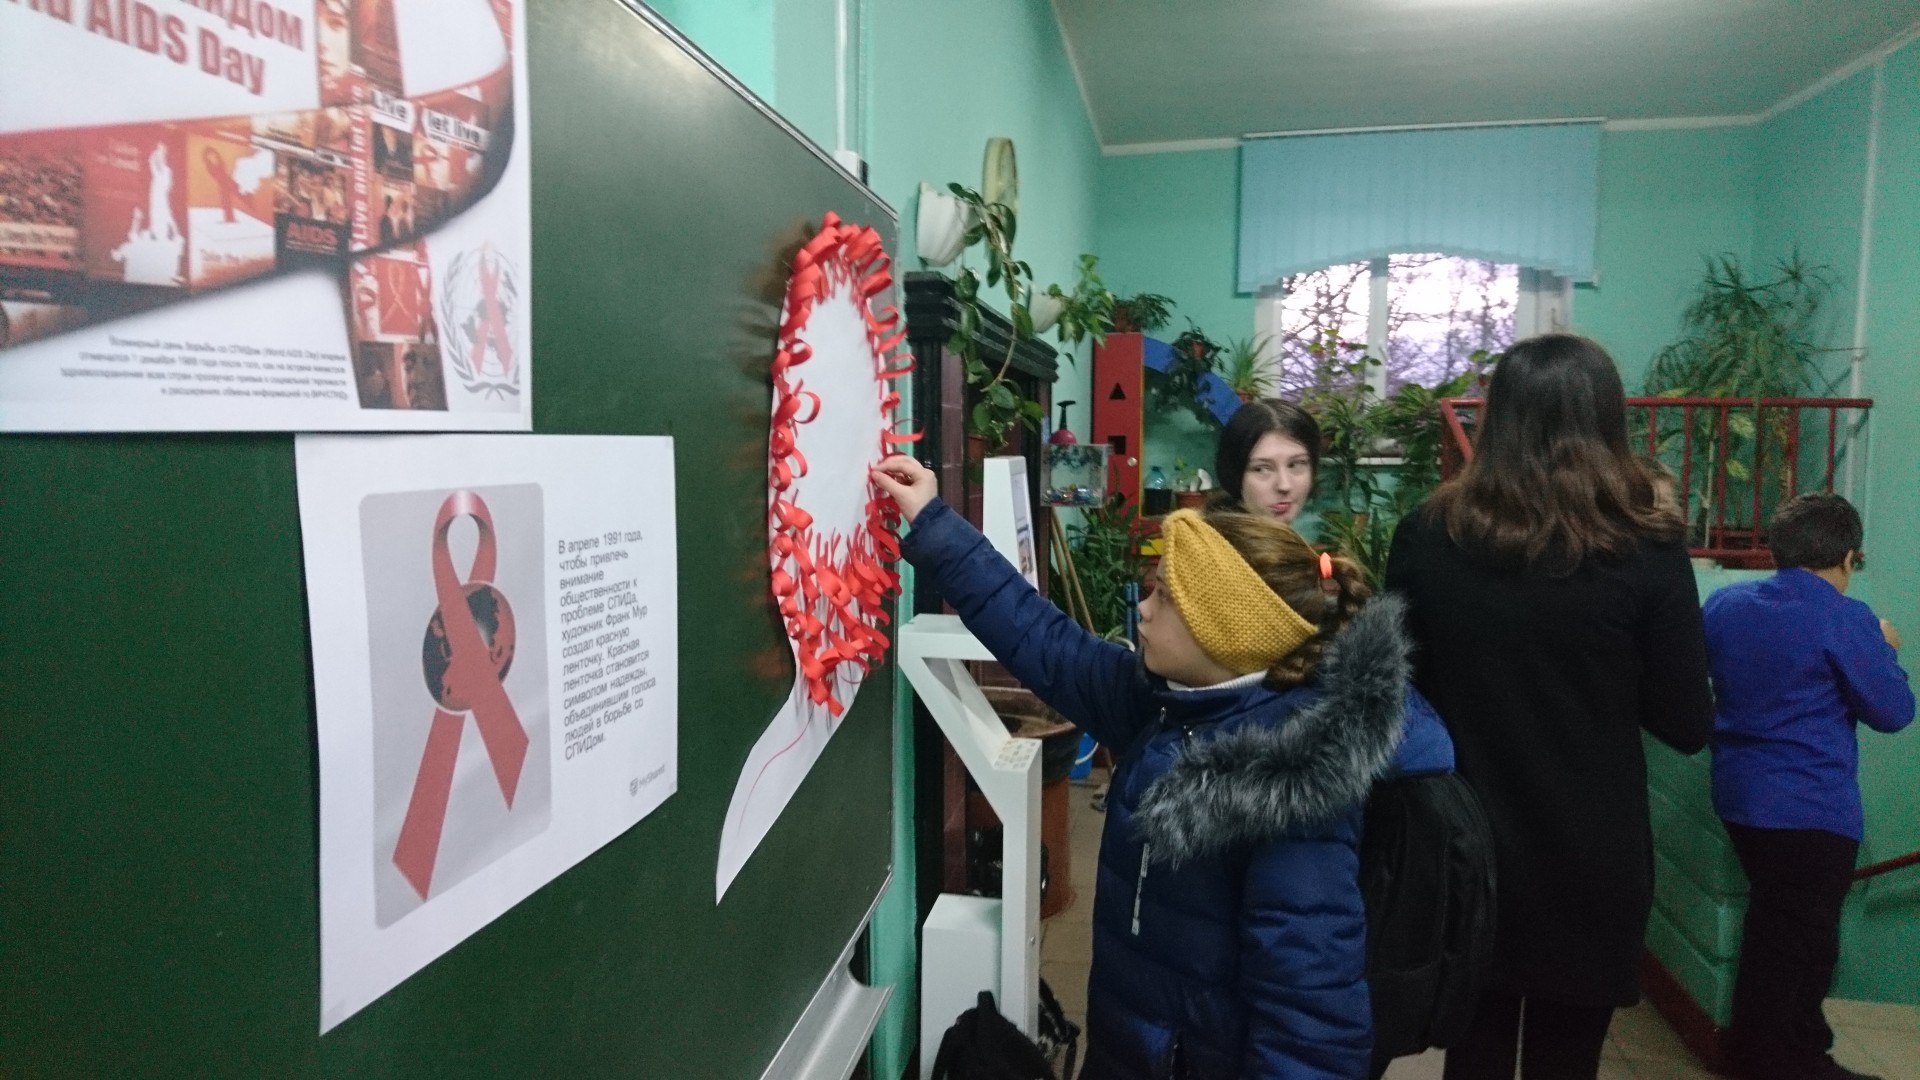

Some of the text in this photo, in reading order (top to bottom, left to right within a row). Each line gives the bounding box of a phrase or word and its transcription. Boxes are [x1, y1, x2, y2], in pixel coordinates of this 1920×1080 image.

[85, 0, 265, 96] AIDS Day
[558, 539, 566, 554] В
[567, 537, 600, 553] апреле
[603, 531, 621, 546] 1991
[559, 549, 629, 571] чтобы привлечь
[560, 570, 604, 590] внимание
[560, 577, 638, 607] общественности к
[561, 602, 604, 626] проблеме
[561, 605, 648, 644] художник Франк Мур
[562, 626, 630, 659] создал красную
[607, 638, 640, 660] Красная
[563, 649, 650, 693] ленточка становится
[564, 682, 608, 710] символом
[564, 676, 656, 727] объединившим голоса
[564, 697, 644, 745] людей в борьбе со
